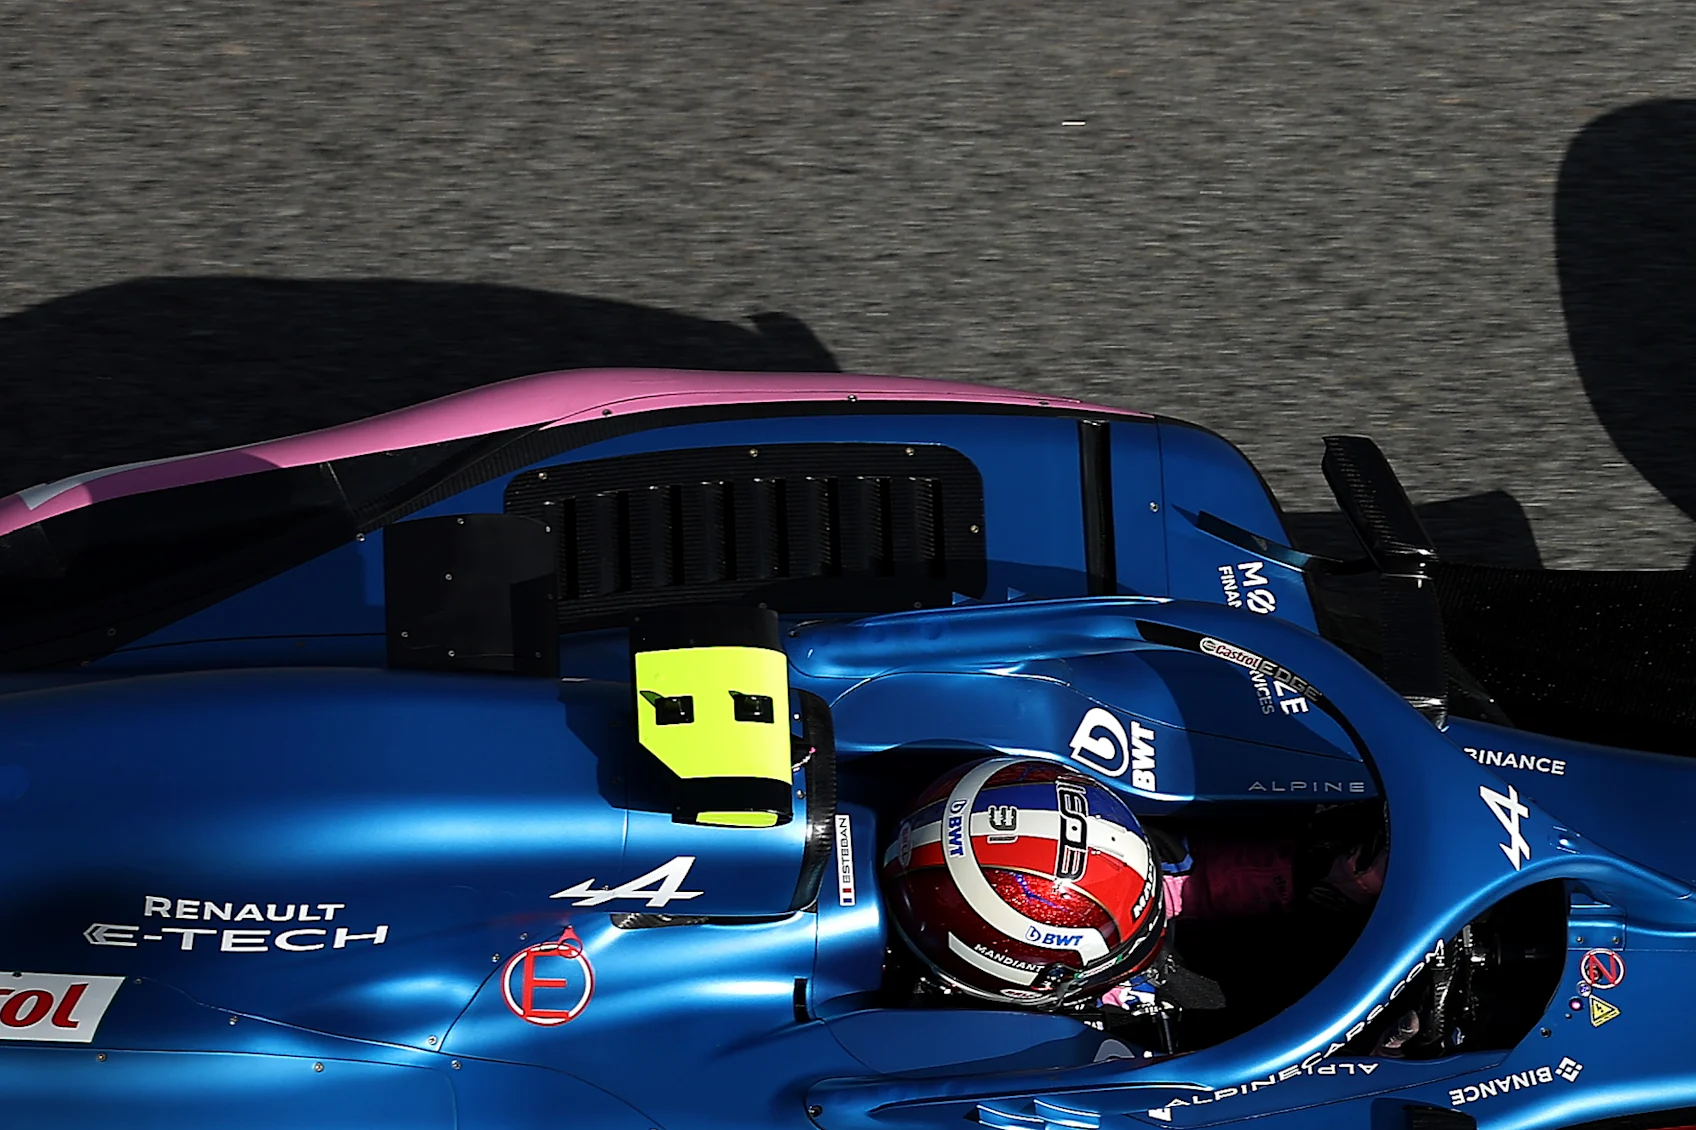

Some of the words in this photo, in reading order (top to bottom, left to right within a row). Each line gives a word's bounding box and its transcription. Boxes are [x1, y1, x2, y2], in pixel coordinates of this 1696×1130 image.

[1216, 645, 1259, 668] Castrol
[1260, 660, 1320, 702] EDGE
[1131, 721, 1156, 791] BWT
[1248, 781, 1365, 792] ALPINE
[838, 817, 851, 884] ESTEBAN
[949, 817, 965, 858] BWT
[143, 895, 345, 922] RENAULT
[83, 922, 389, 952] E-TECH
[1042, 933, 1084, 946] BWT
[974, 943, 1045, 973] MANDIANT
[1449, 1065, 1554, 1107] BINANCE
